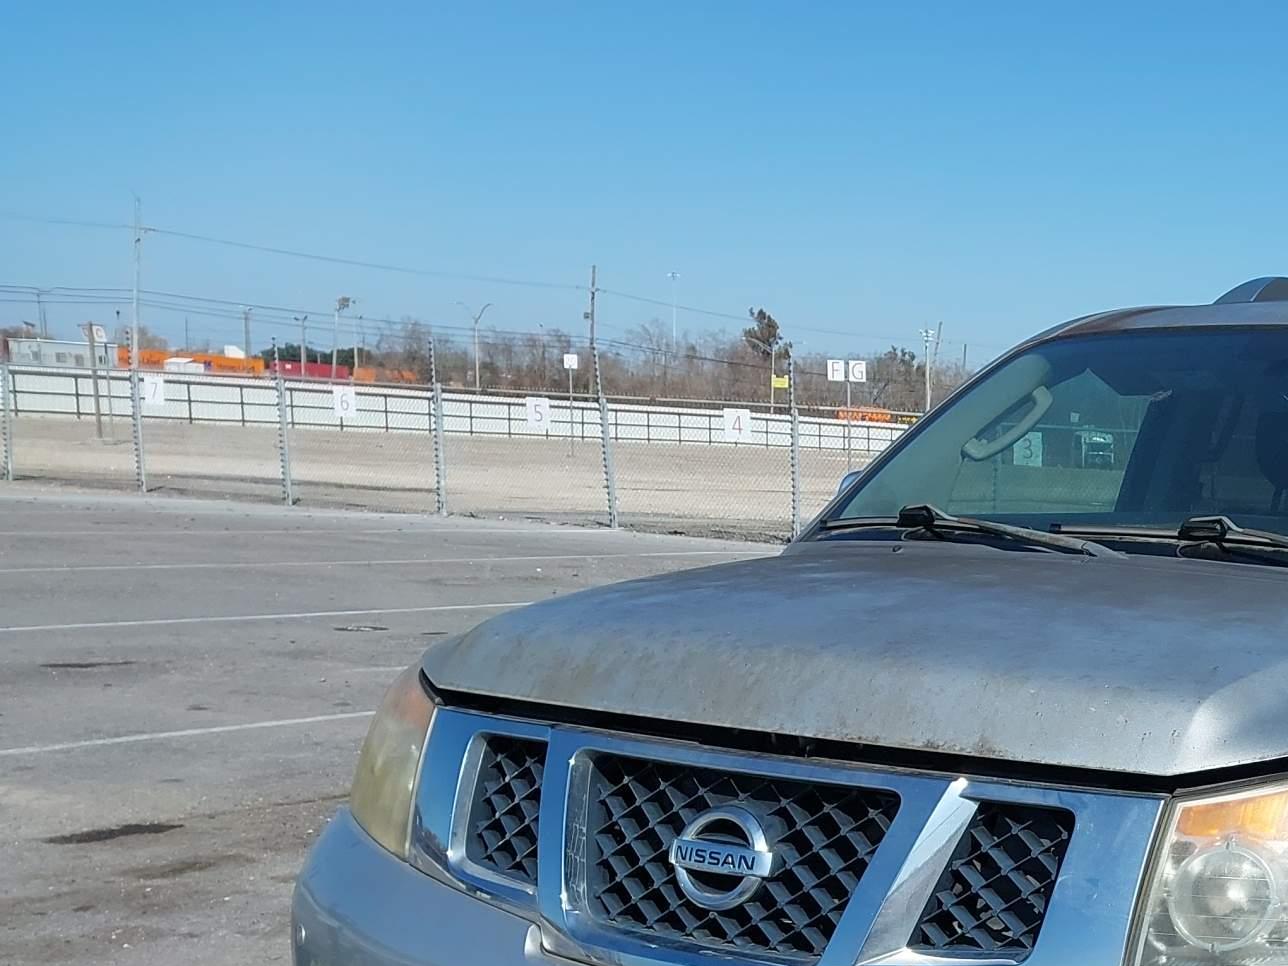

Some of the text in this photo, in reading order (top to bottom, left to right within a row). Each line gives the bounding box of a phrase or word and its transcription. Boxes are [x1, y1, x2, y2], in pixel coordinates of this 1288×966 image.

[831, 361, 841, 380] F
[851, 362, 864, 380] G
[150, 382, 158, 400] 7
[340, 392, 350, 411] 6
[534, 404, 543, 422] 5
[731, 415, 744, 435] 4
[1023, 438, 1033, 459] 3
[675, 845, 756, 871] NISSAN
